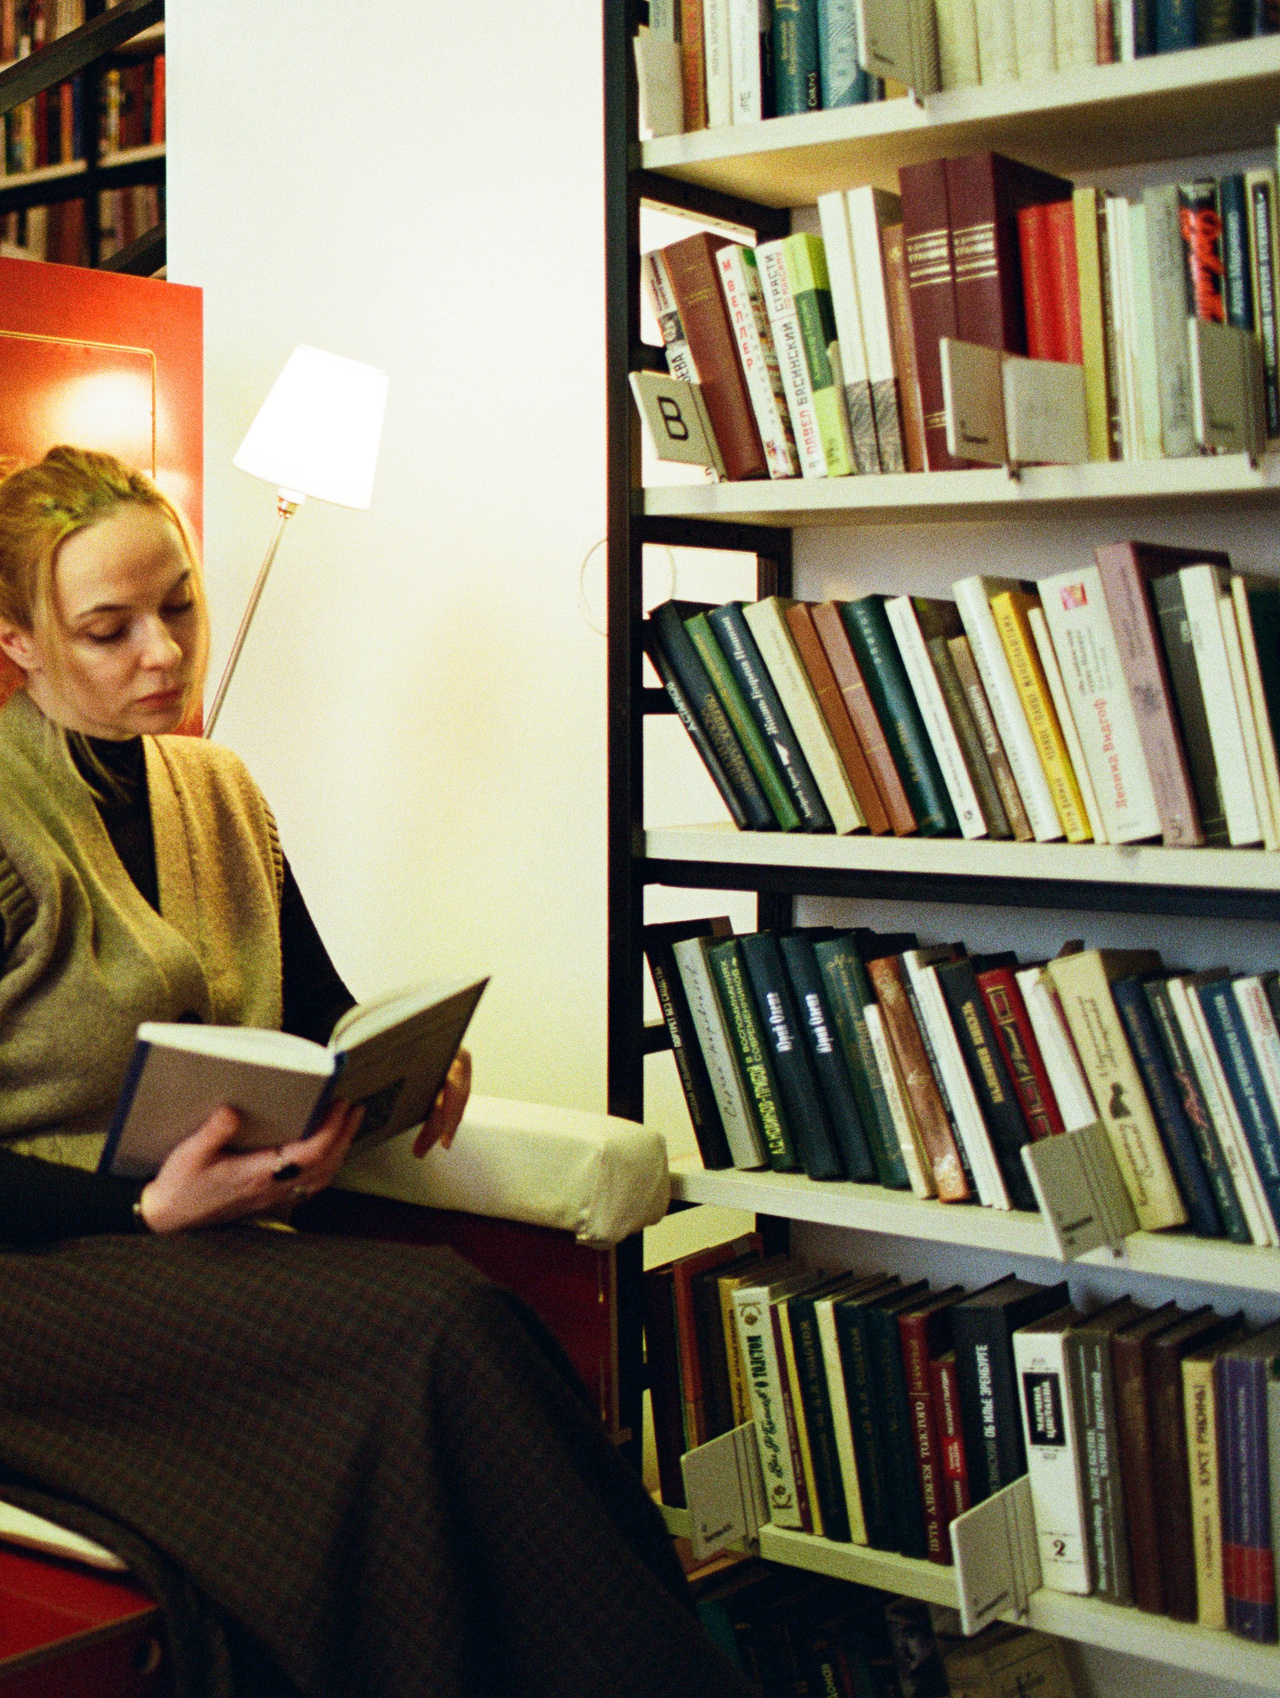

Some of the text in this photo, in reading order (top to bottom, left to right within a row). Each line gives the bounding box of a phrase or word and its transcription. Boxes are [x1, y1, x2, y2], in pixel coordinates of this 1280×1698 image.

[764, 252, 786, 312] СТРАСТИ
[779, 320, 818, 455] ПАВЕЛ БАСИНСКИЙ
[755, 697, 779, 736] Жизнь
[967, 683, 998, 755] Казакевич
[1091, 696, 1118, 752] Видгоф
[1104, 753, 1129, 810] Леонид
[652, 965, 670, 1002] СХОДСТВА
[662, 1001, 674, 1016] БЕЗ
[718, 958, 751, 1053] ВОСПОМИНАНИЯХ
[666, 1015, 682, 1048] ПОРТРЕТ
[729, 967, 764, 1062] СОВРЕМЕННИКОВ
[771, 1022, 796, 1053] Юрий
[811, 1023, 836, 1055] Юрий
[960, 999, 1004, 1104] ВАЛЕНТИН ПИКУЛЬ
[746, 1334, 767, 1378] ТОЛСТОМ
[974, 1343, 993, 1397] ЭРЕНБУРГЕ
[979, 1398, 995, 1423] ИЛЬЕ
[982, 1425, 996, 1438] ОБ
[1032, 1384, 1045, 1432] МАРИНА
[1041, 1379, 1057, 1438] ЦВЕТАЕВА
[1193, 1383, 1208, 1443] РЯБИНЫ
[914, 1400, 941, 1552] ПУТЬ АЛЕКСЕЯ ТОЛСТОГО
[1197, 1450, 1211, 1485] КУСТ
[1052, 1538, 1069, 1560] 2
